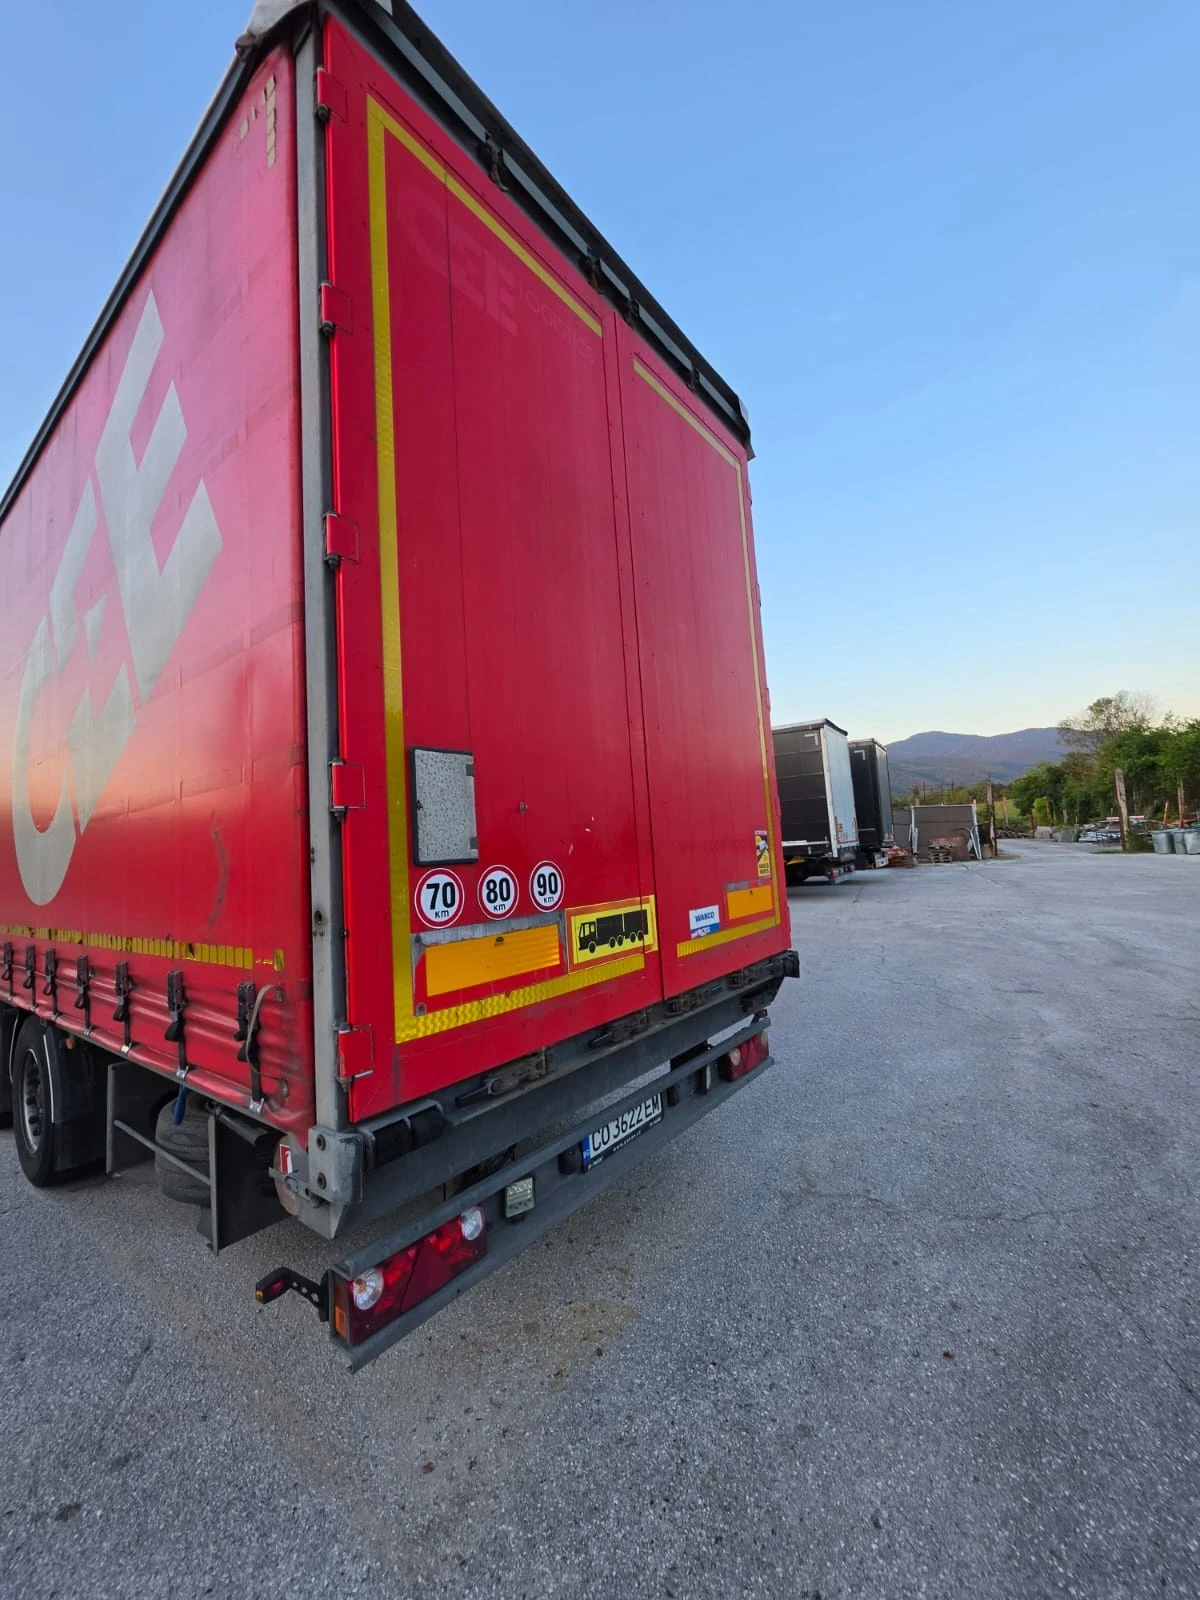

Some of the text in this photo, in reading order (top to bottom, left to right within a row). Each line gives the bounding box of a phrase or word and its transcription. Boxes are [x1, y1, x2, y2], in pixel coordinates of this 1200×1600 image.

[426, 881, 456, 910] 70
[486, 877, 511, 904] 80
[537, 872, 558, 897] 90
